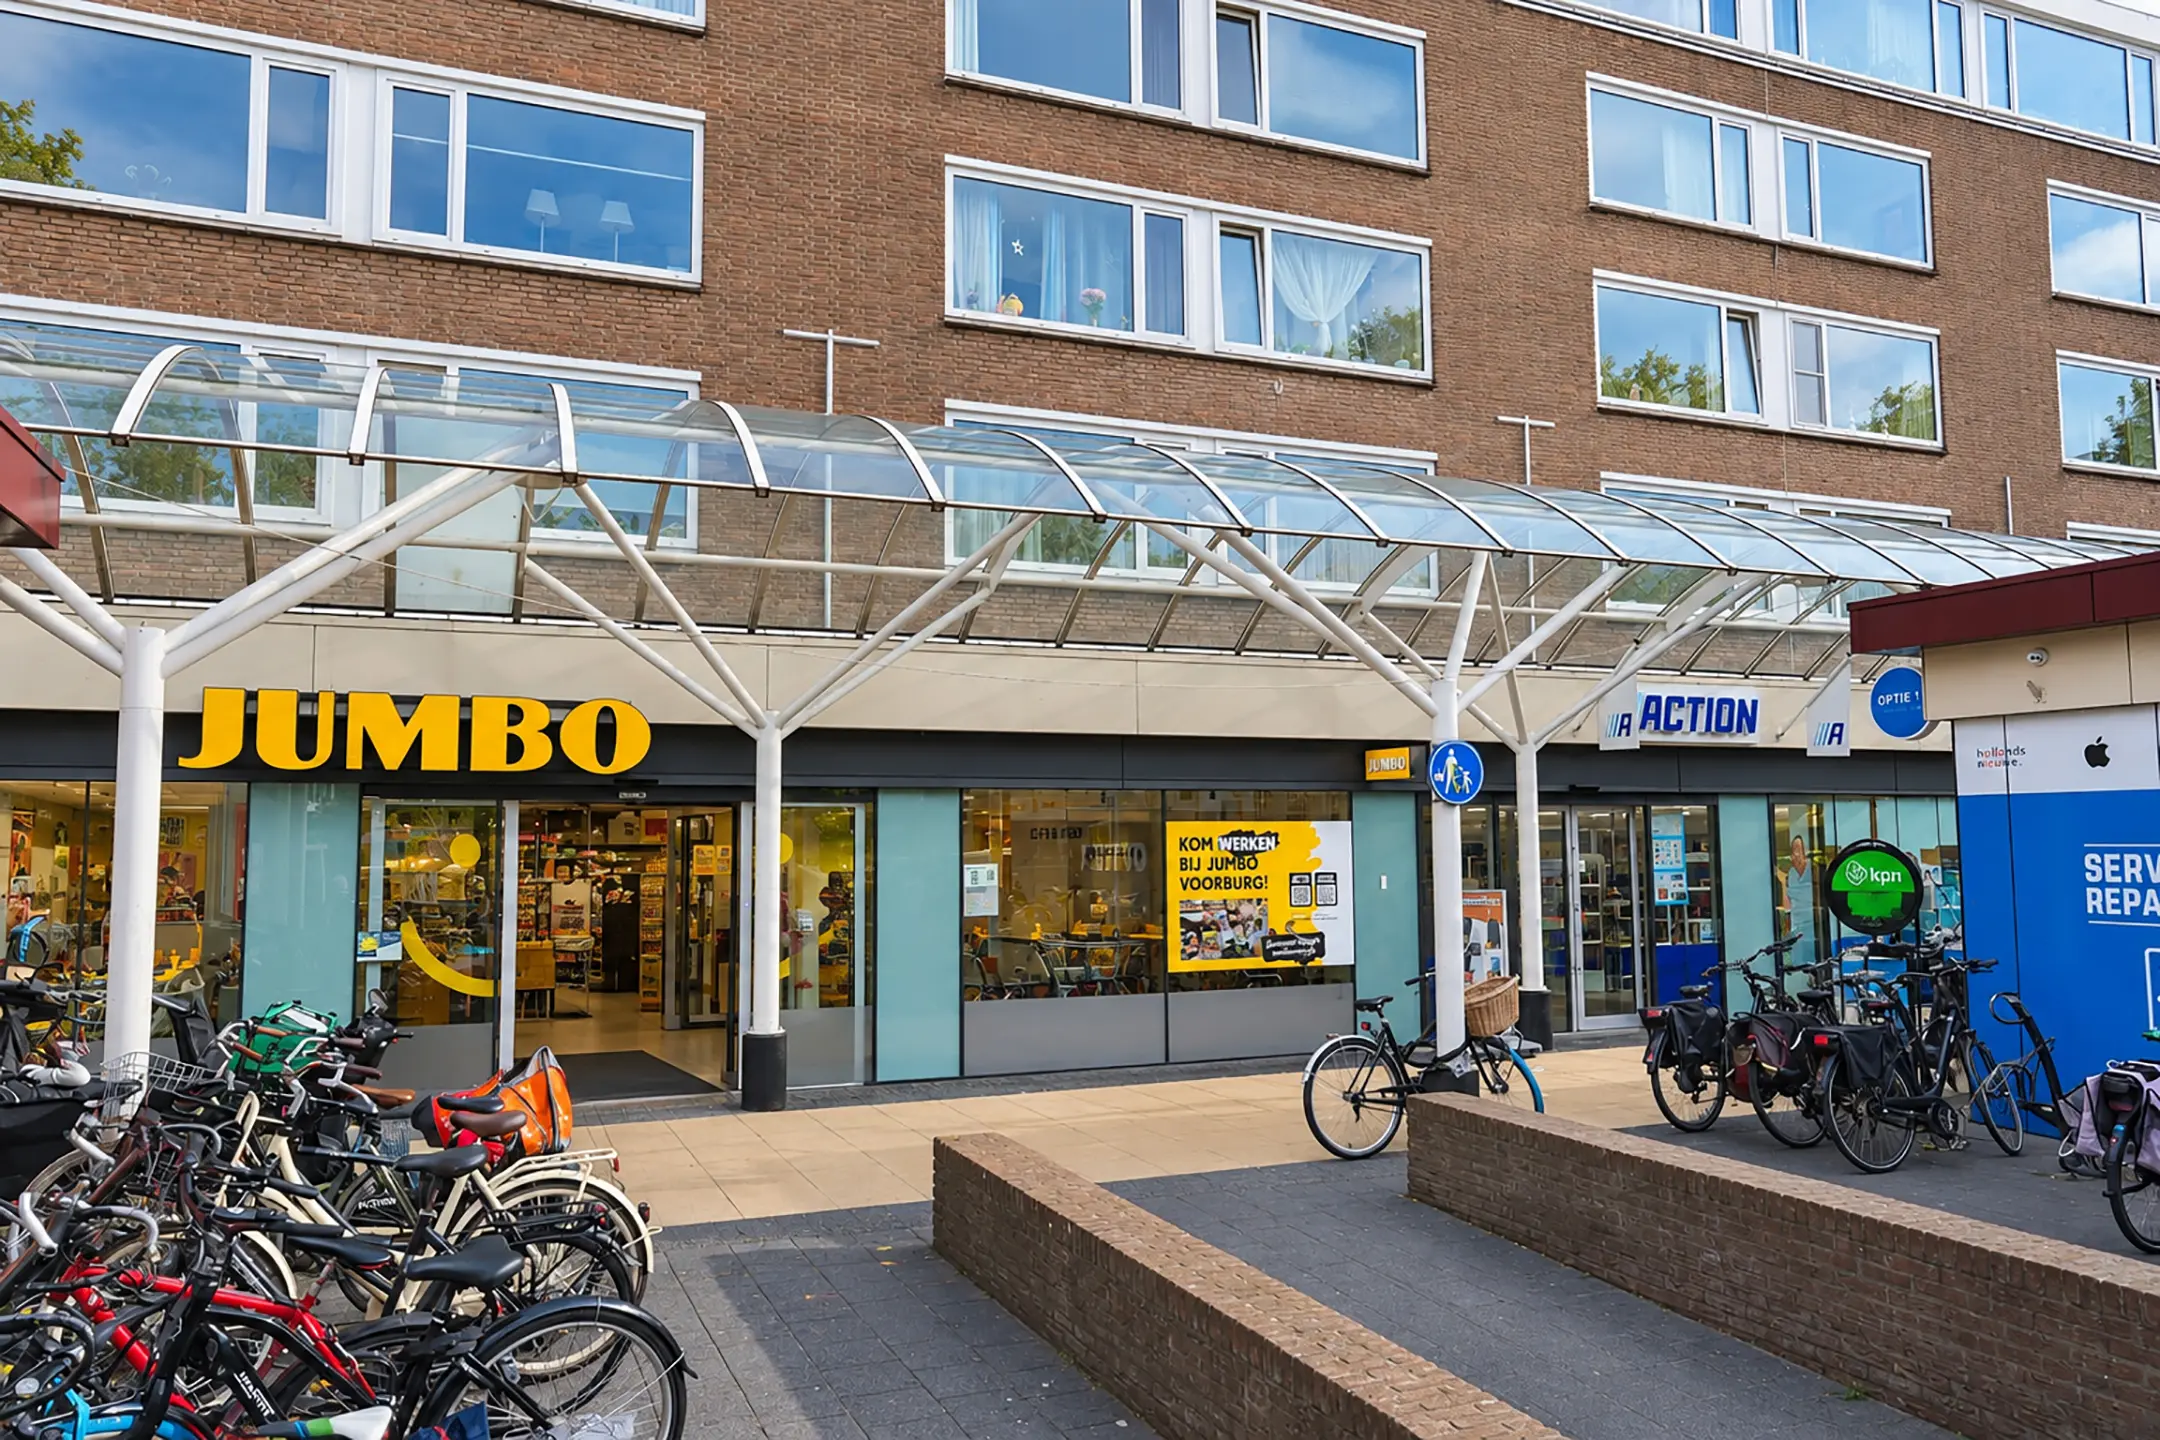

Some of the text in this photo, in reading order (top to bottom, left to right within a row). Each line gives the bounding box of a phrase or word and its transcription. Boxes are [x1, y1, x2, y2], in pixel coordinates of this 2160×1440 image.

[1877, 692, 1911, 706] OPTIE
[1639, 694, 1759, 734] ACTION
[178, 687, 651, 775] JUMBO
[1368, 756, 1406, 772] JUMBO
[1179, 835, 1277, 852] KOM WERKEN
[1179, 855, 1259, 871] BIJ JUMBO
[1179, 875, 1269, 891] VOORBURG!
[1869, 867, 1903, 887] kpn
